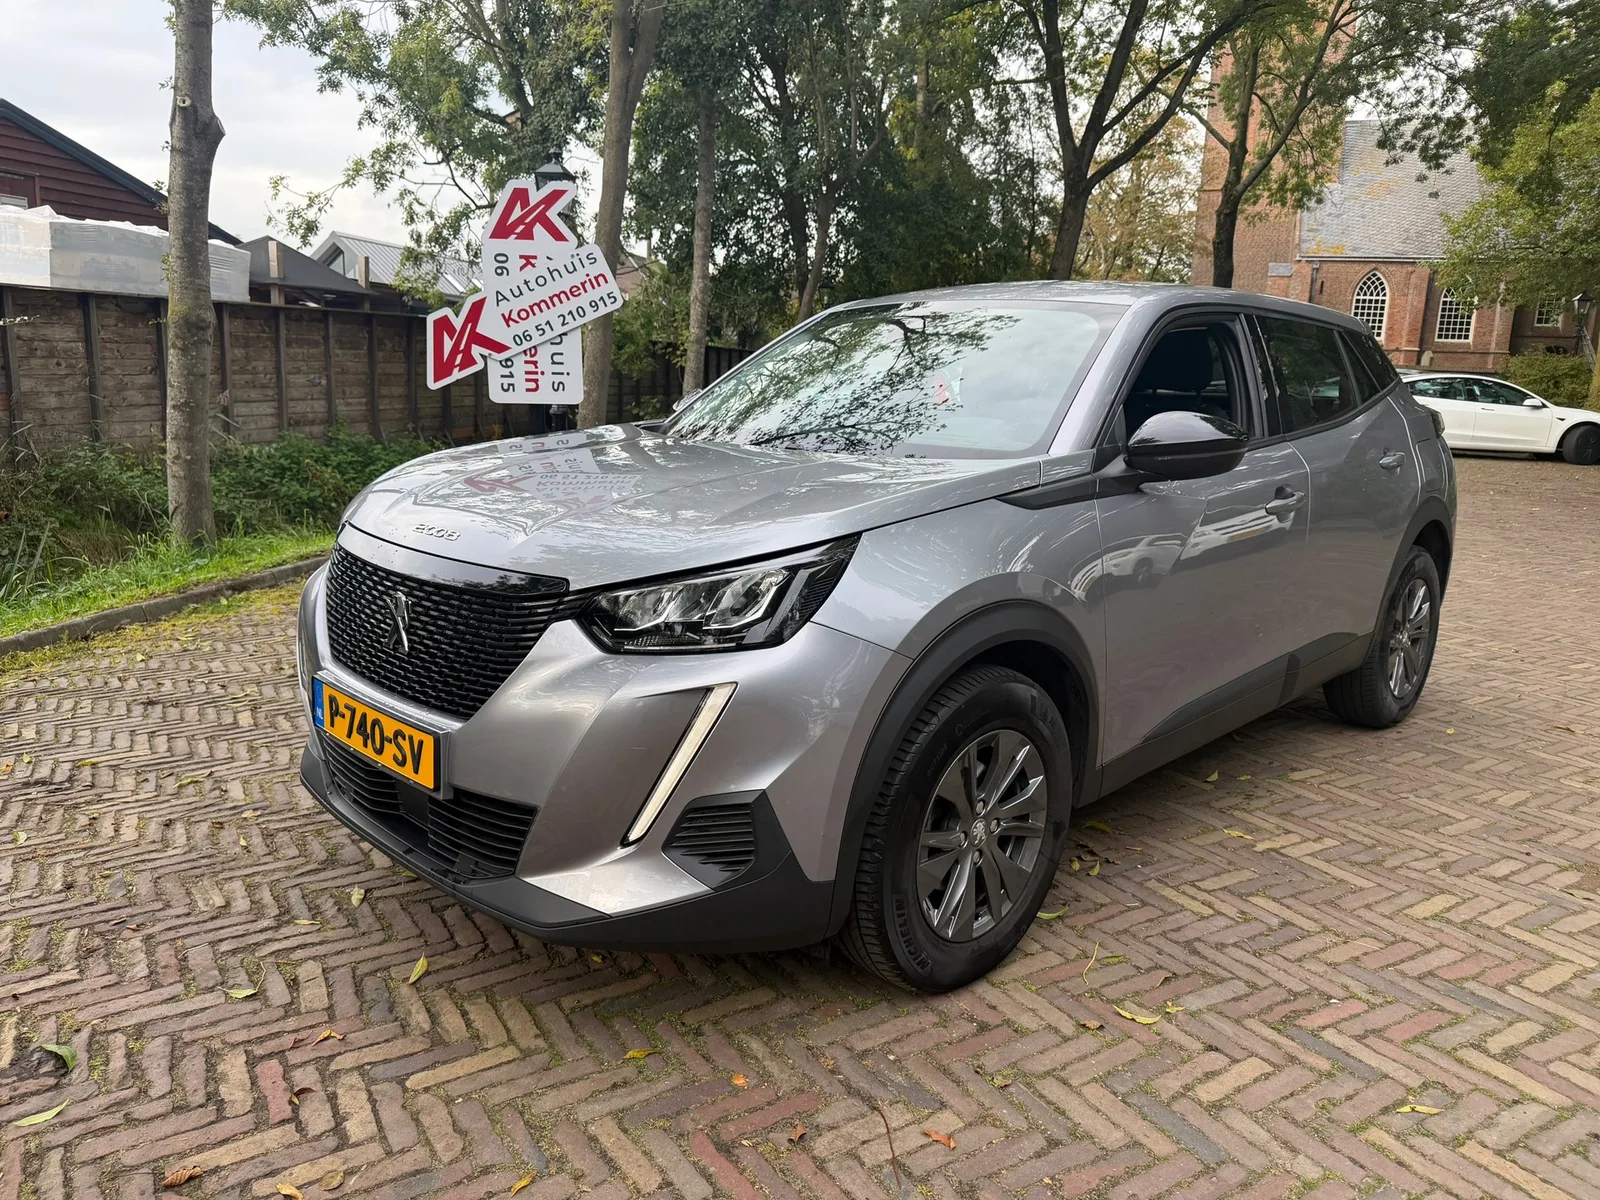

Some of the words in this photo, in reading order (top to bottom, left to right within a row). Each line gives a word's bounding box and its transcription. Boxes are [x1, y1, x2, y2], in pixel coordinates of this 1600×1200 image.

[494, 253, 509, 276] 06
[495, 252, 597, 307] Autohuis
[519, 255, 537, 272] K
[501, 272, 609, 328] Kommerin
[512, 329, 533, 346] 06
[535, 320, 554, 337] 51
[557, 306, 586, 326] 210
[591, 291, 617, 314] 915
[499, 358, 515, 392] 915
[523, 345, 545, 392] erin
[550, 332, 570, 392] huis
[412, 523, 461, 541] 2008
[316, 706, 324, 720] NL
[328, 694, 424, 775] P-740-SV
[895, 897, 932, 972] MICHELIN
